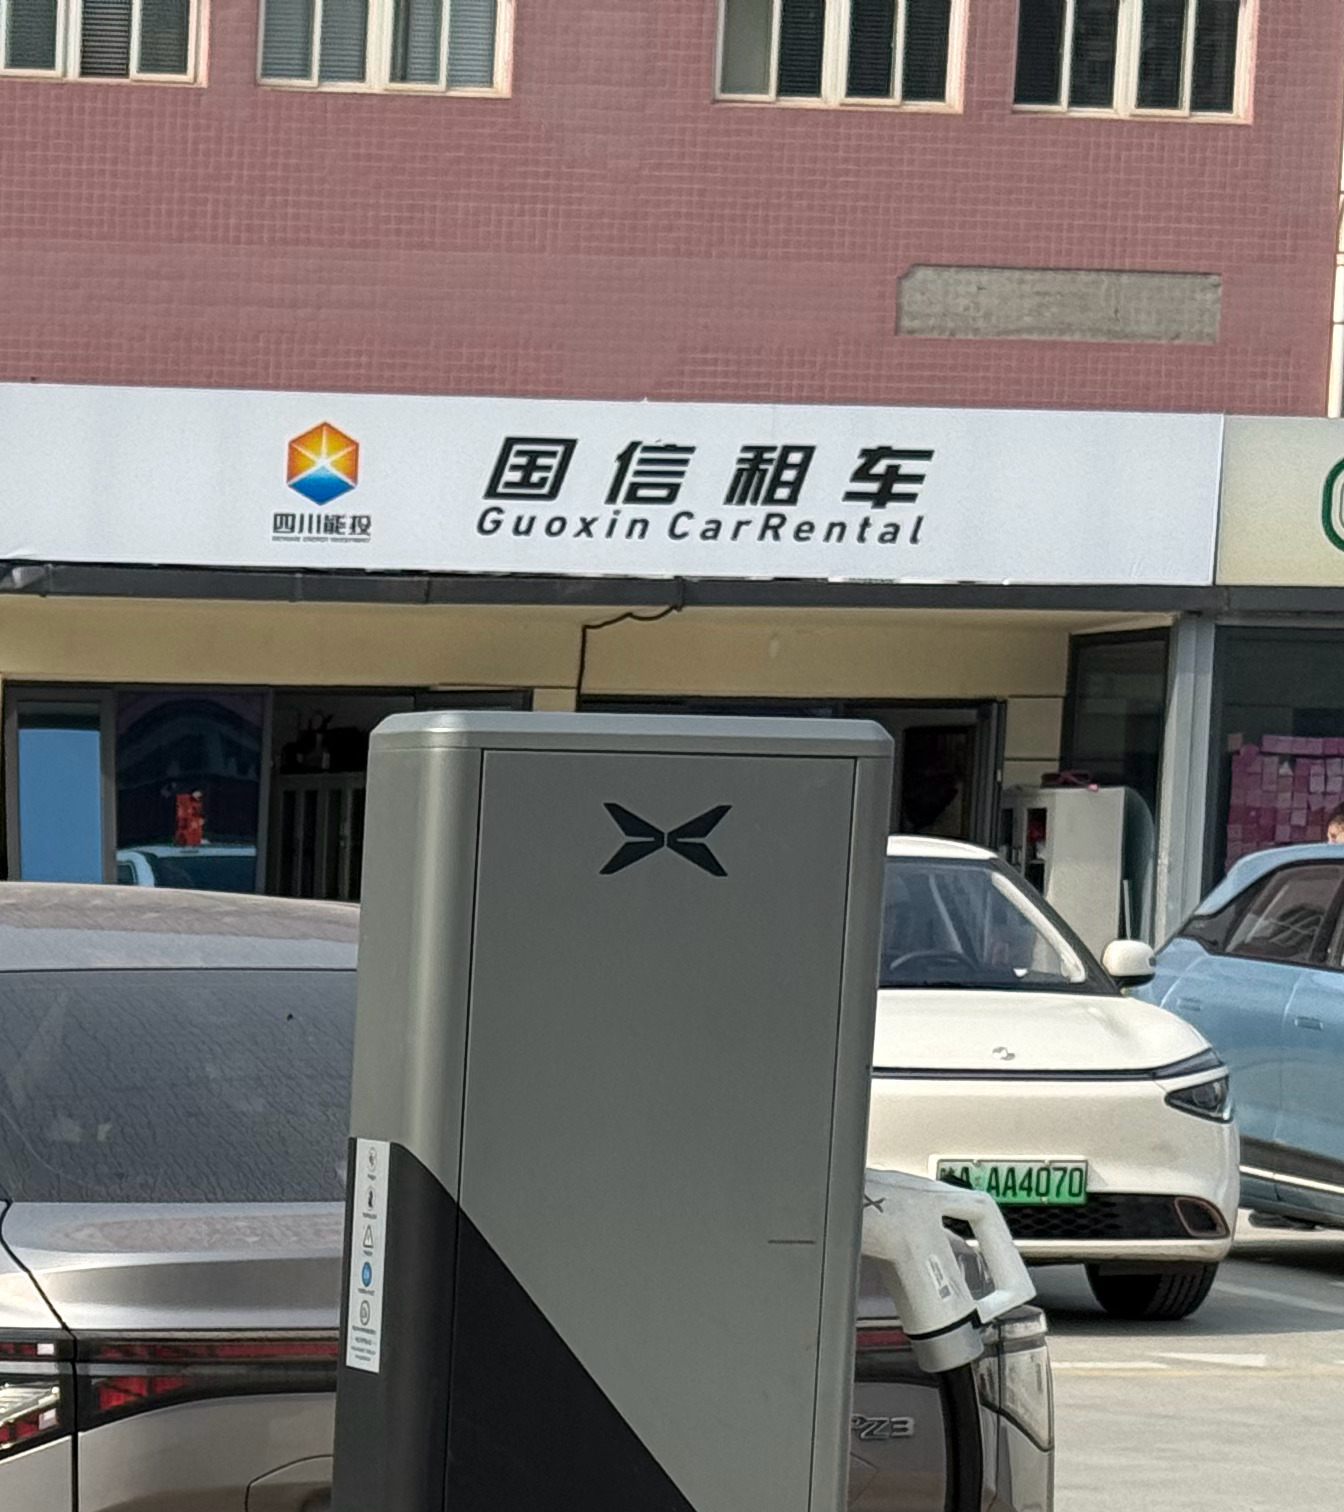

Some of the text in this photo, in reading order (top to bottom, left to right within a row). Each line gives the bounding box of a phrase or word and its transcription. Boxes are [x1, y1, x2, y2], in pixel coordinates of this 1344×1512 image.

[483, 436, 935, 508] 国信租车
[272, 512, 372, 537] 四川能投
[476, 505, 649, 541] Guoxin
